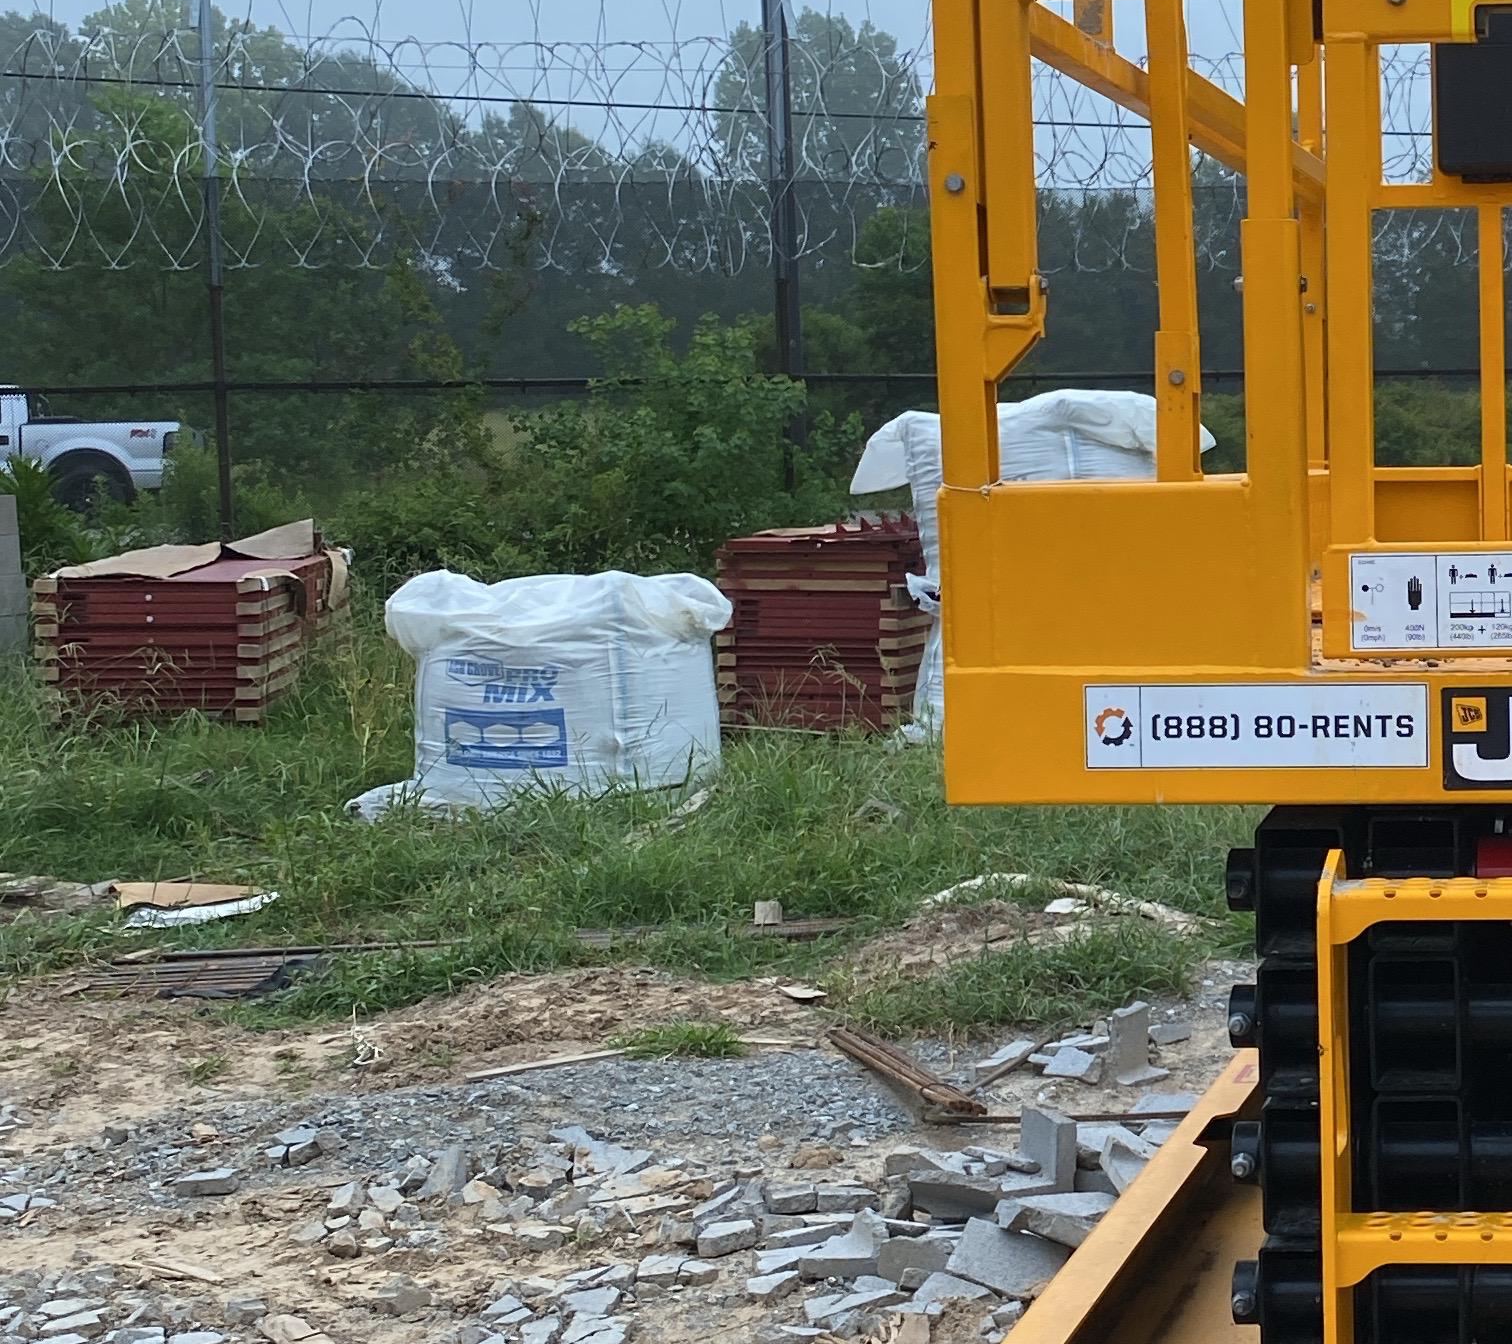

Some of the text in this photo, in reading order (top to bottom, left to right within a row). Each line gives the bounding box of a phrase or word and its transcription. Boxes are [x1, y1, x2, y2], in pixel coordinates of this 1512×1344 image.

[505, 664, 560, 683] PRO
[483, 681, 559, 704] MIX
[1460, 706, 1482, 723] JCB
[1151, 714, 1415, 741] (888) 80-RENTS
